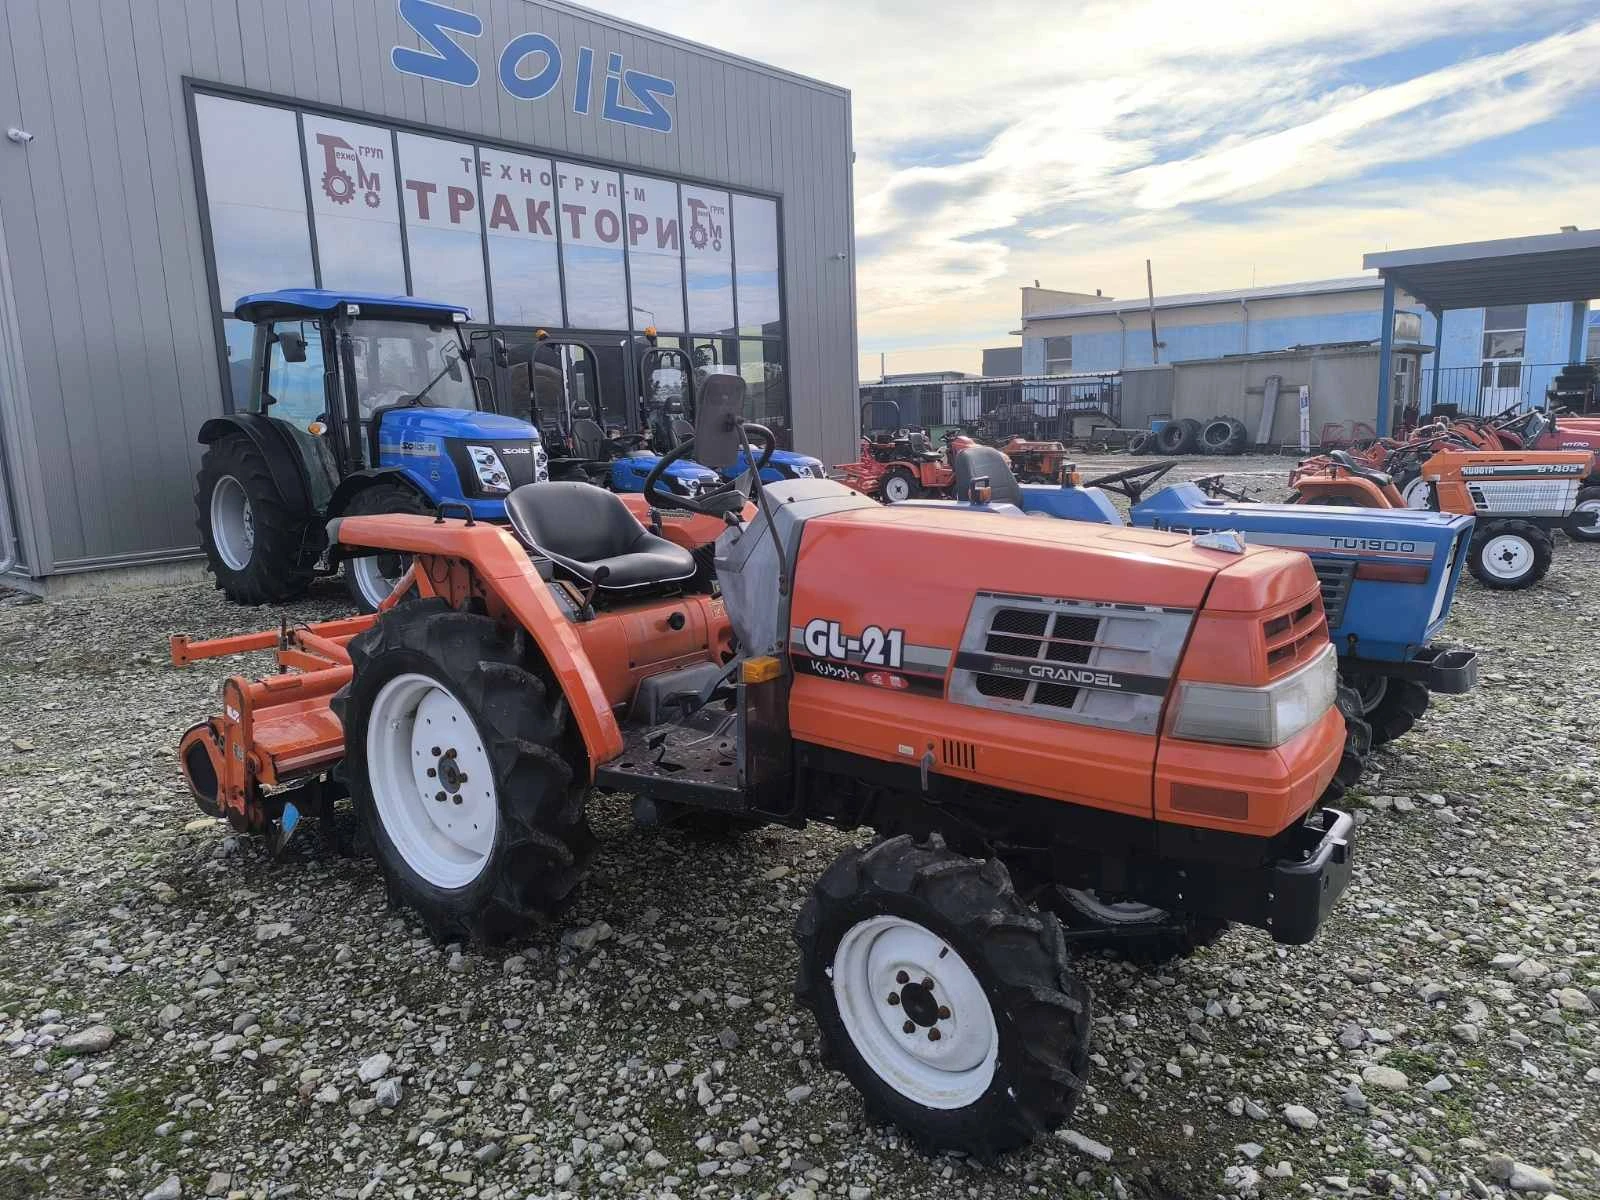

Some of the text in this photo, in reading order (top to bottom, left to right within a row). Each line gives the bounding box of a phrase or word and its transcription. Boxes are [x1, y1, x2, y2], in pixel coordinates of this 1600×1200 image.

[405, 180, 680, 250] ТРАКТОРИ
[1329, 537, 1415, 553] TU1900
[804, 618, 905, 669] GL-21
[810, 659, 861, 681] Kubota
[1028, 664, 1122, 688] GRANDEL
